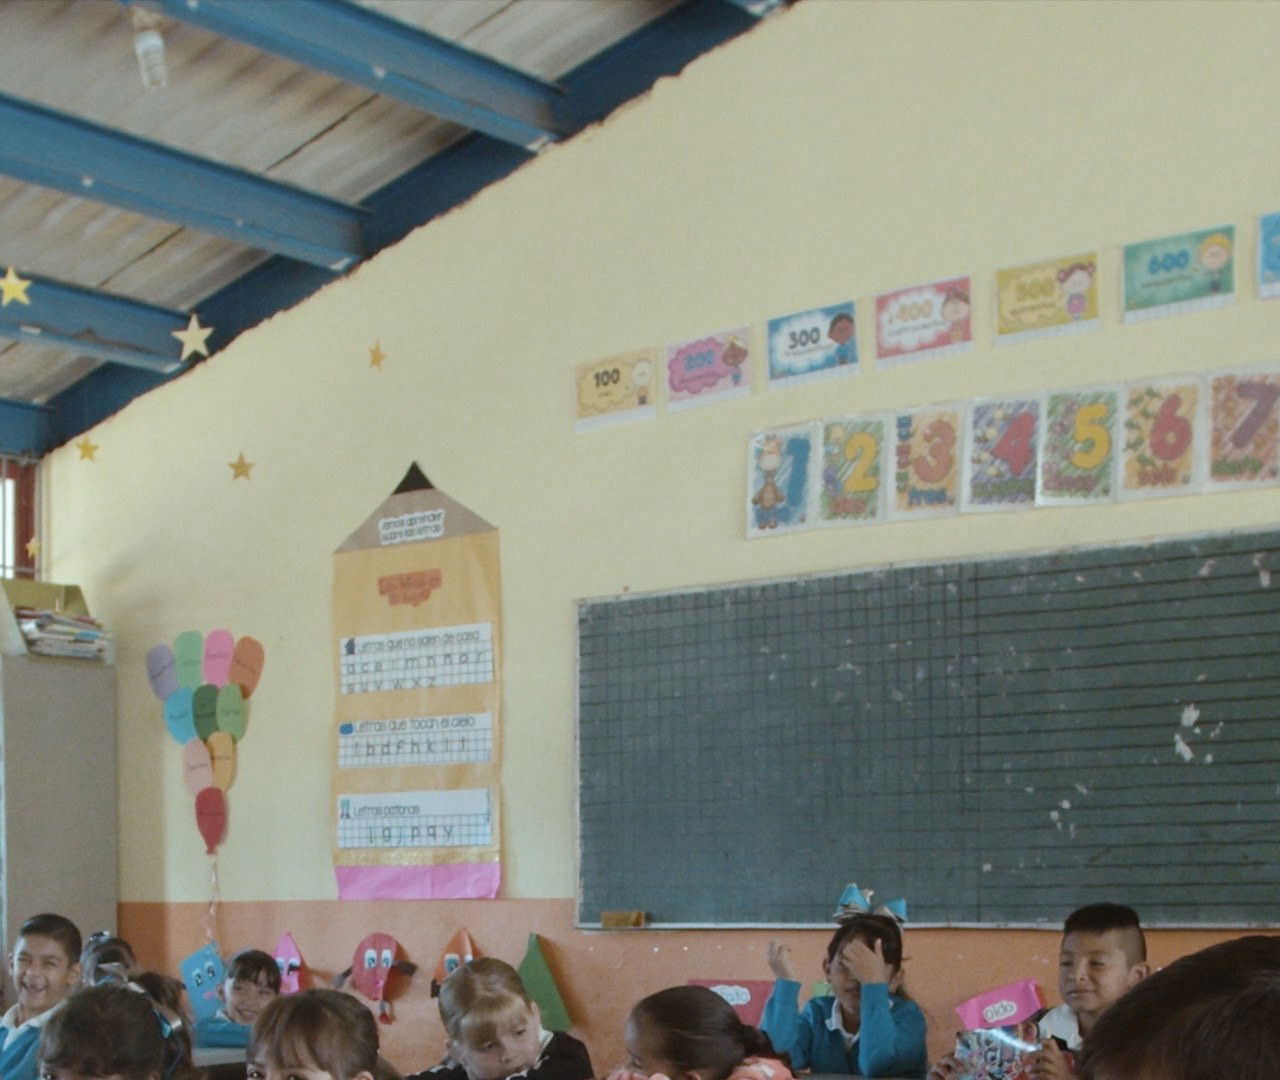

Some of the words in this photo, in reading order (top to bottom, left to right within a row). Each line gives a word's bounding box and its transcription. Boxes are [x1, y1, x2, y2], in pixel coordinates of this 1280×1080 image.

[1148, 248, 1190, 275] 600
[1015, 278, 1055, 301] 500
[787, 327, 821, 351] 300
[594, 368, 620, 389] 100
[1070, 402, 1111, 469] 5
[1149, 394, 1192, 461] 6
[912, 418, 956, 483] 3
[994, 411, 1037, 476] 4
[785, 436, 812, 508] 1
[844, 431, 879, 492] 2
[442, 632, 455, 643] de
[388, 720, 407, 731] que
[366, 741, 376, 756] b
[381, 740, 390, 755] d
[411, 738, 420, 753] h
[353, 805, 382, 817] Letras
[382, 826, 392, 842] g
[411, 825, 421, 842] p
[427, 824, 436, 841] q
[443, 824, 454, 841] y
